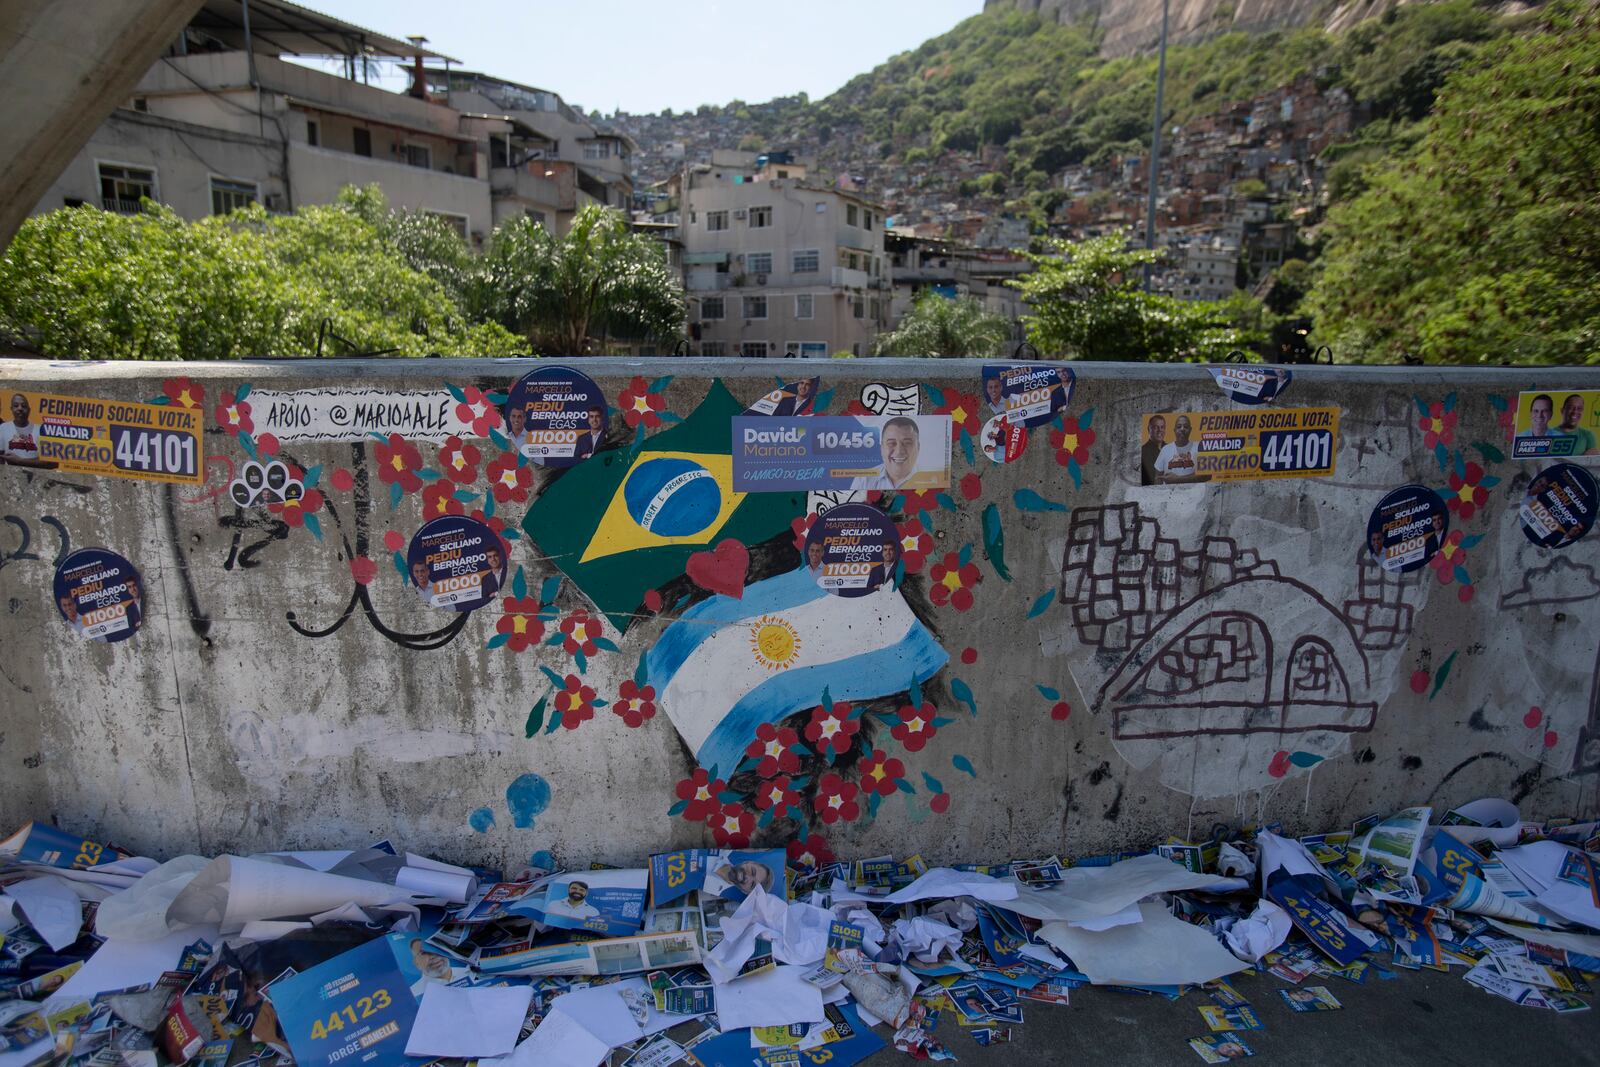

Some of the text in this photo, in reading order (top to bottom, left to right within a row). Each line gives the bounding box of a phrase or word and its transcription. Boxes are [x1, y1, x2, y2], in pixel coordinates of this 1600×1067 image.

[1000, 367, 1032, 379] PEDIU
[1007, 370, 1055, 386] BERNARDO
[1225, 369, 1265, 383] 11000
[1024, 378, 1048, 391] EGAS
[542, 394, 588, 402] SICILIANO
[1009, 388, 1050, 408] 11000
[40, 398, 196, 429] PEDRINHO SOCIAL VOTA:
[525, 402, 564, 411] PEDIU
[531, 412, 588, 420] BERNARDO
[1200, 412, 1334, 431] PEDRINHO SOCIAL VOTA:
[44, 425, 89, 440] WALDIR
[549, 420, 577, 429] EGAS
[531, 431, 577, 443] 11000
[744, 426, 800, 443] David
[817, 432, 875, 448] 10456
[40, 441, 111, 463] BRAZÃO
[116, 430, 194, 474] 44101
[744, 444, 806, 457] Mariano
[1202, 439, 1241, 450] WALDIR
[1263, 432, 1330, 470] 44101
[1552, 440, 1572, 452] 55
[1197, 451, 1259, 471] BRAZÃO
[750, 468, 783, 480] AMIGO
[784, 469, 797, 480] DO
[797, 466, 825, 480] BEM!
[1548, 481, 1572, 506] PEDIU
[1564, 486, 1587, 514] SICILIANO
[643, 504, 658, 526] ORDEM
[657, 493, 664, 502] E
[1394, 503, 1430, 519] SICILIANO
[1546, 490, 1577, 525] BERNARDO
[1549, 506, 1567, 524] EGAS
[1383, 516, 1412, 531] PEDIU
[1532, 501, 1559, 532] 11000
[1388, 518, 1432, 538] BERNARDO
[1402, 527, 1424, 540] EGAS
[422, 533, 465, 548] MARCELLO
[440, 537, 481, 551] SICILIANO
[824, 537, 861, 546] PEDIU
[1390, 537, 1425, 557] 11000
[426, 549, 462, 564] PEDIU
[829, 545, 882, 553] BERNARDO
[433, 553, 486, 571] BERNARDO
[845, 553, 871, 562] EGAS
[64, 565, 104, 582] MARCELLO
[81, 568, 120, 585] SICILIANO
[452, 563, 478, 577] EGAS
[827, 563, 871, 575] 11000
[70, 581, 103, 598] PEDIU
[437, 574, 480, 592] 11000
[79, 584, 127, 604] BERNARDO
[96, 594, 120, 608] EGAS
[86, 604, 126, 625] 11000
[1283, 896, 1346, 950] 44123
[832, 925, 861, 938] 15015
[310, 989, 392, 1039] 44123
[328, 1040, 360, 1064] JORGE
[361, 1020, 399, 1047] CANELLA
